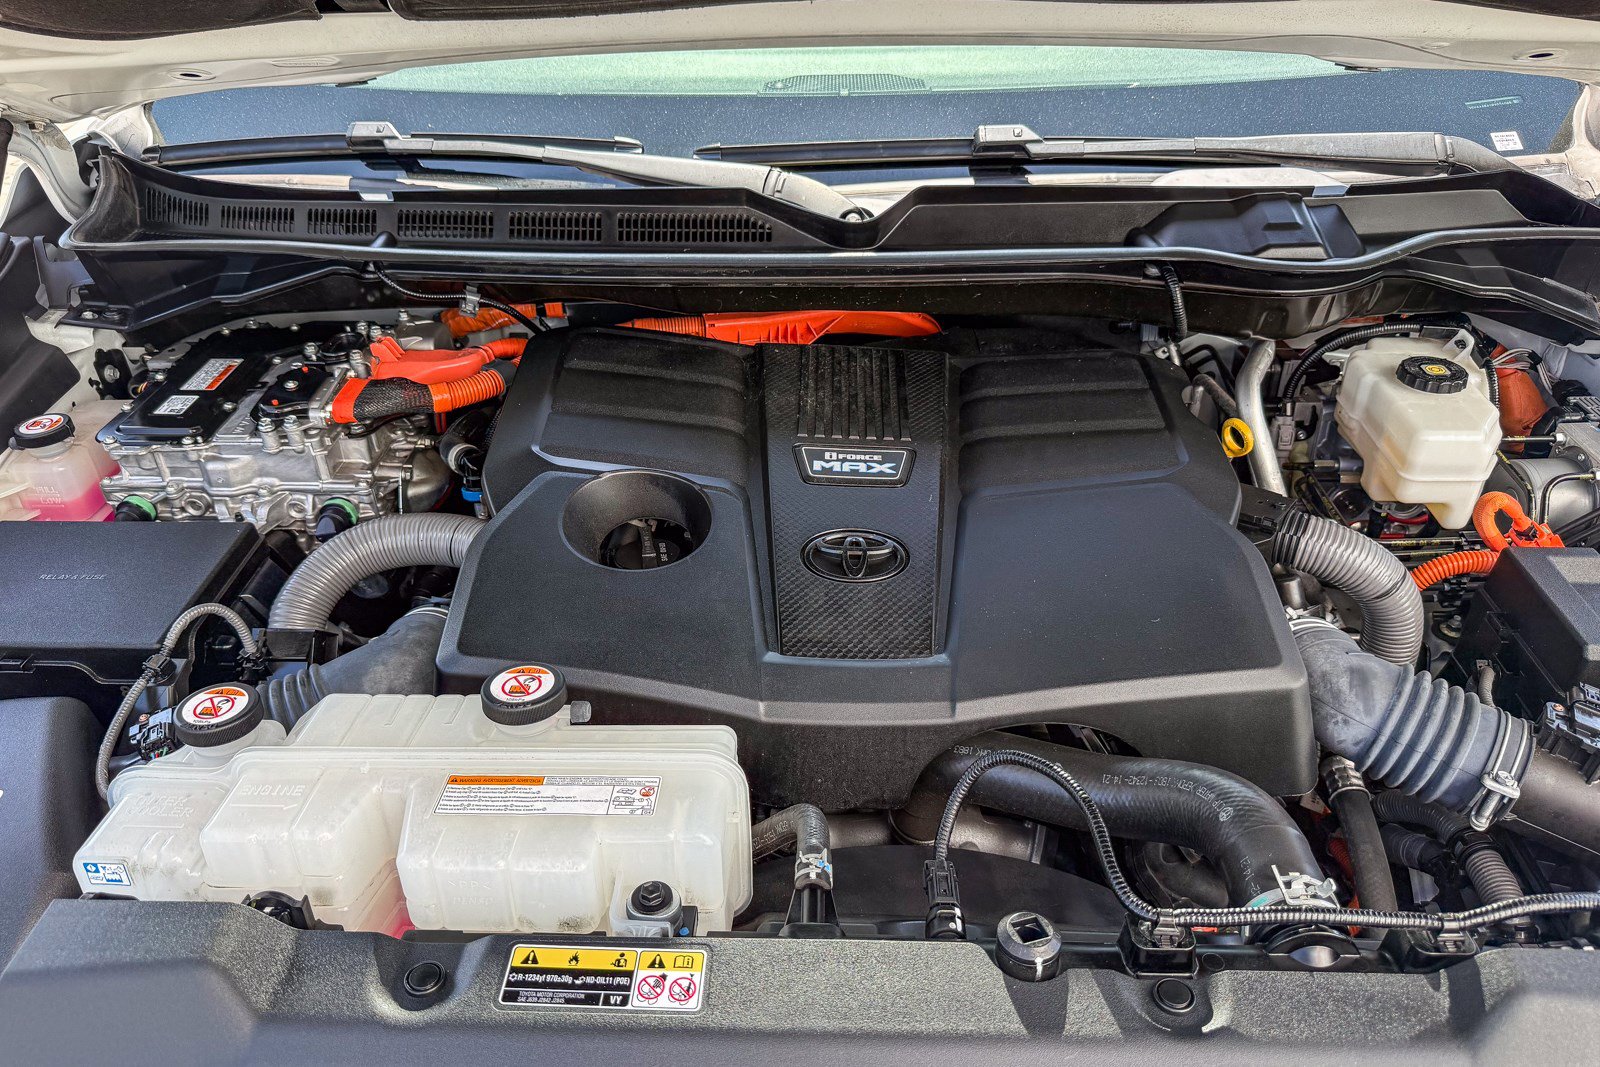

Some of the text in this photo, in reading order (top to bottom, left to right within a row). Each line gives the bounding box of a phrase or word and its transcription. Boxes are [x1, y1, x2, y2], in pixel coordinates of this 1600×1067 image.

[812, 460, 897, 474] MAX
[239, 784, 306, 796] ENGINE
[517, 974, 546, 983] R-1234yf
[547, 974, 573, 984] 970±30g
[613, 976, 631, 986] (POE)
[609, 995, 622, 1005] VY
